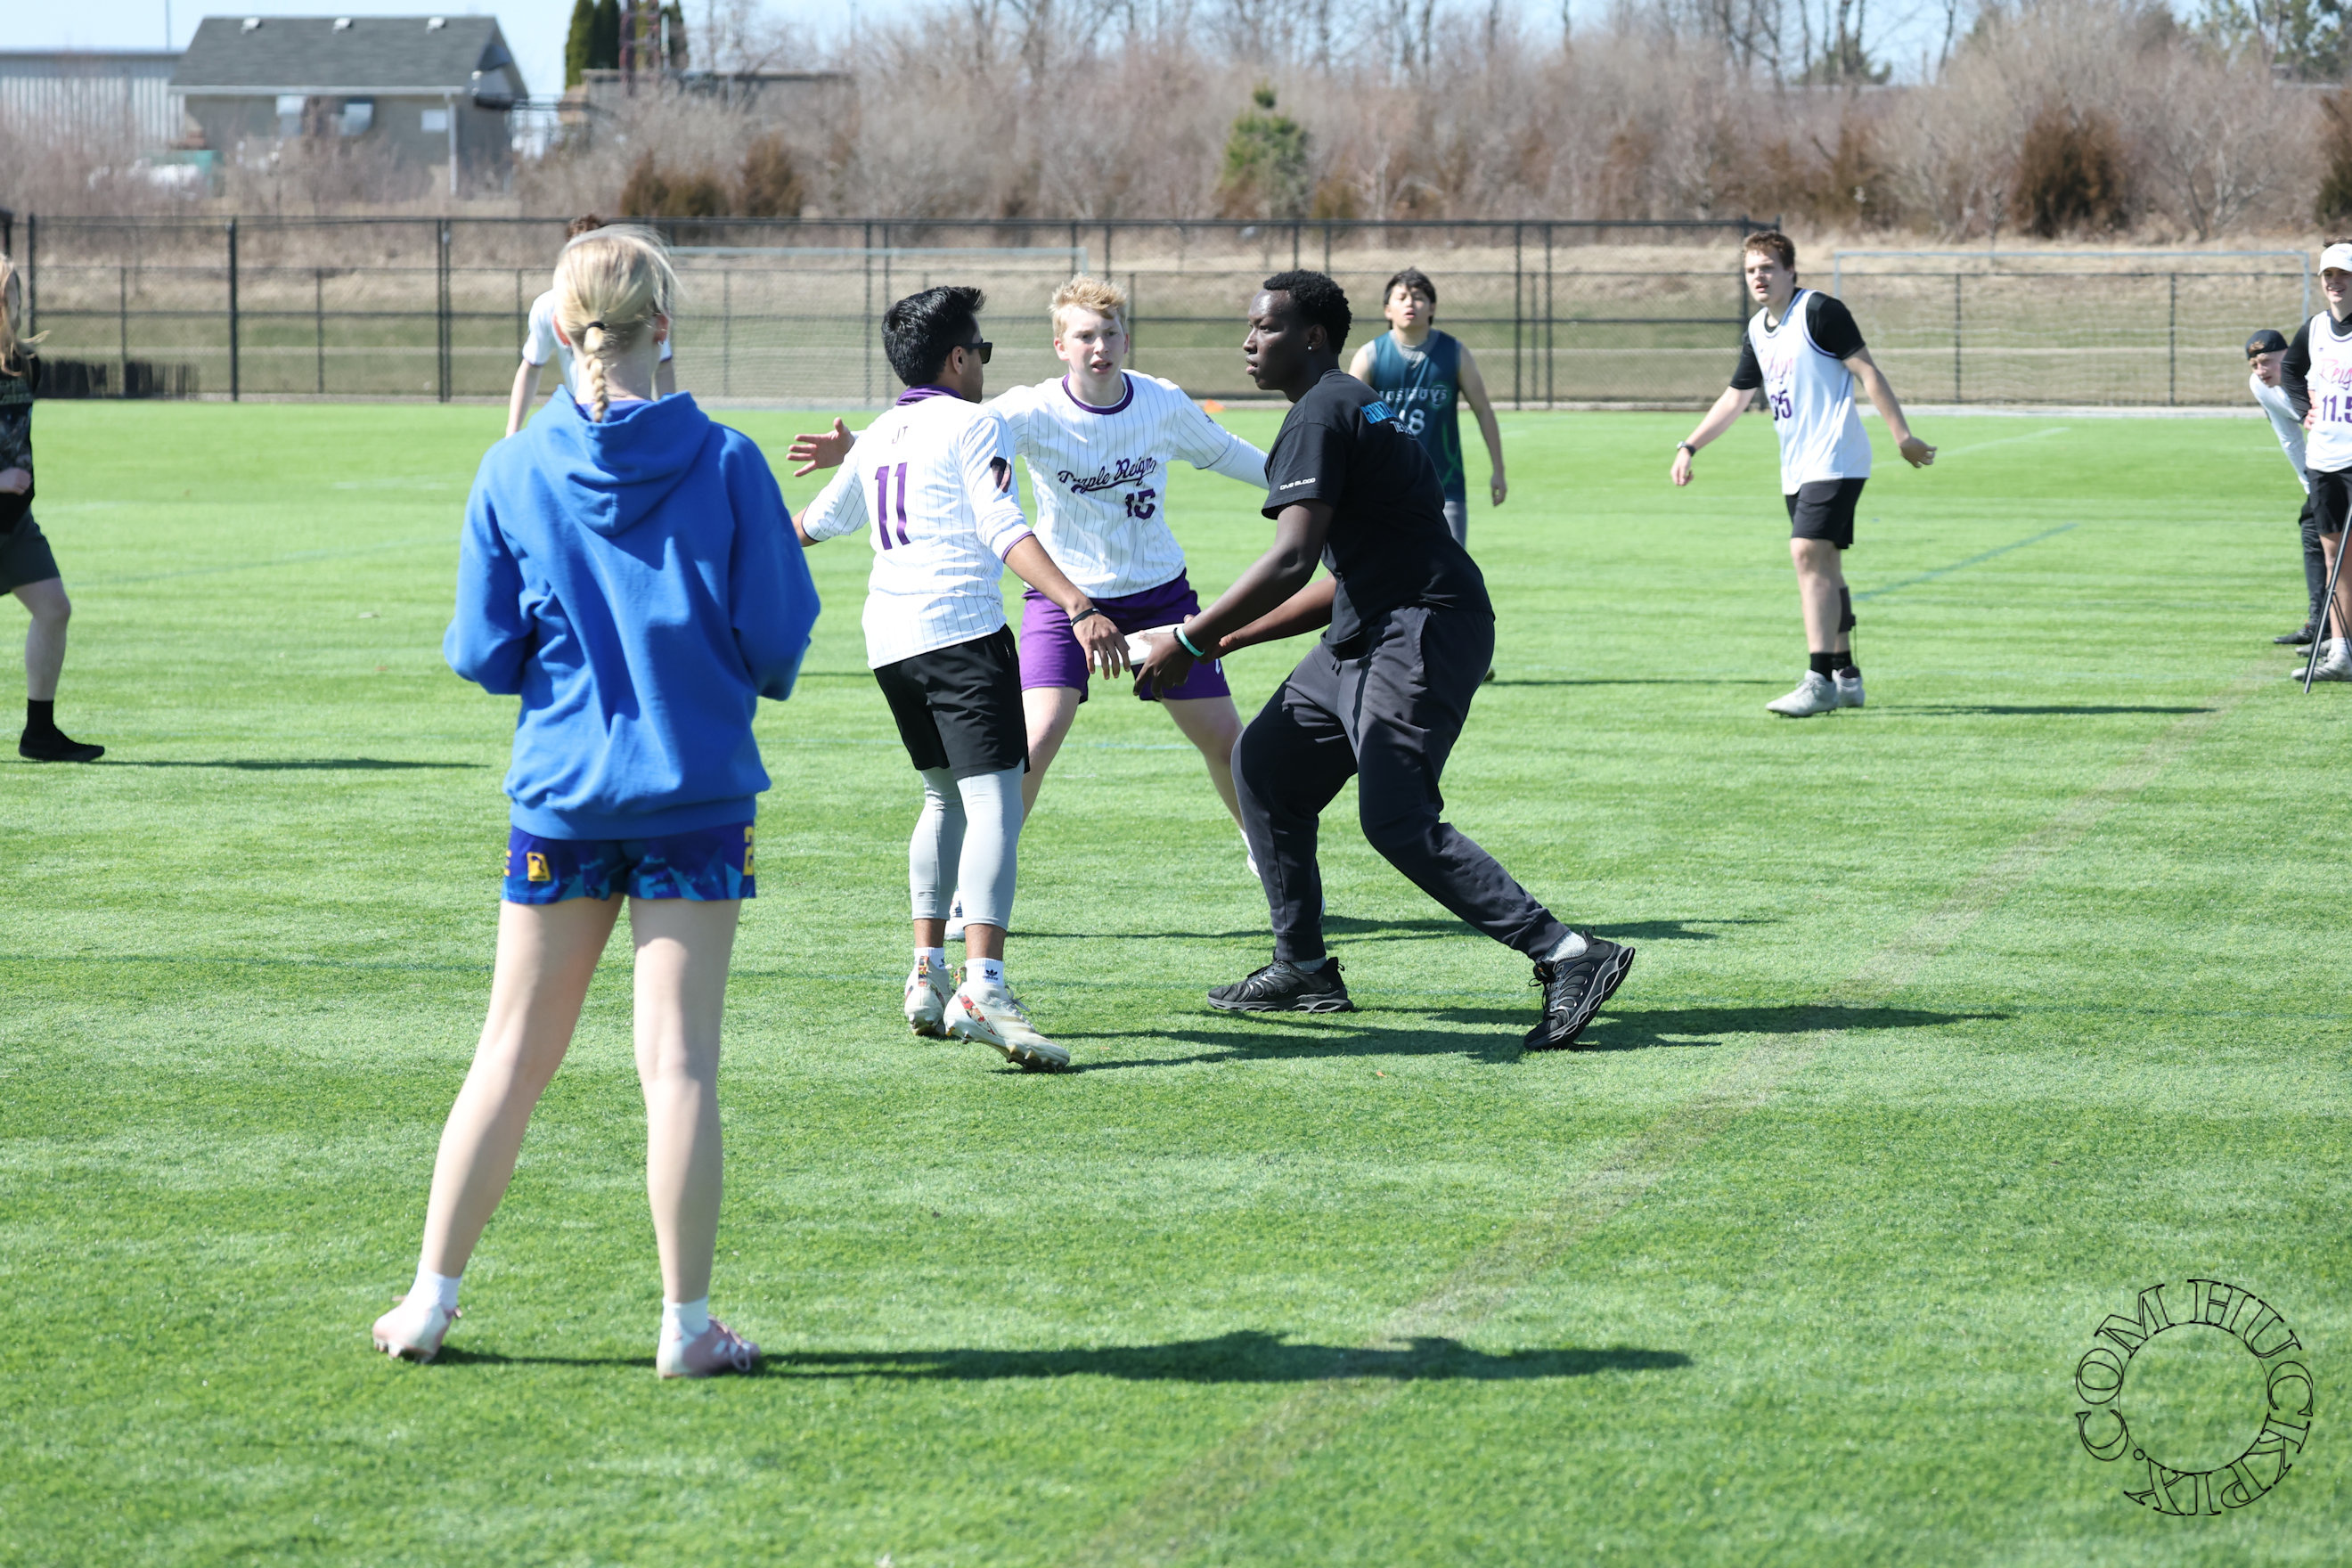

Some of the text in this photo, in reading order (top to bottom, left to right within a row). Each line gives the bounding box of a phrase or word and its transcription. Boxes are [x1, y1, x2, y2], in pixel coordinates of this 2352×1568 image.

[1058, 457, 1157, 488] Purple Reign
[1294, 478, 1316, 486] BLOOD
[874, 461, 911, 551] 11
[1125, 488, 1156, 520] 15
